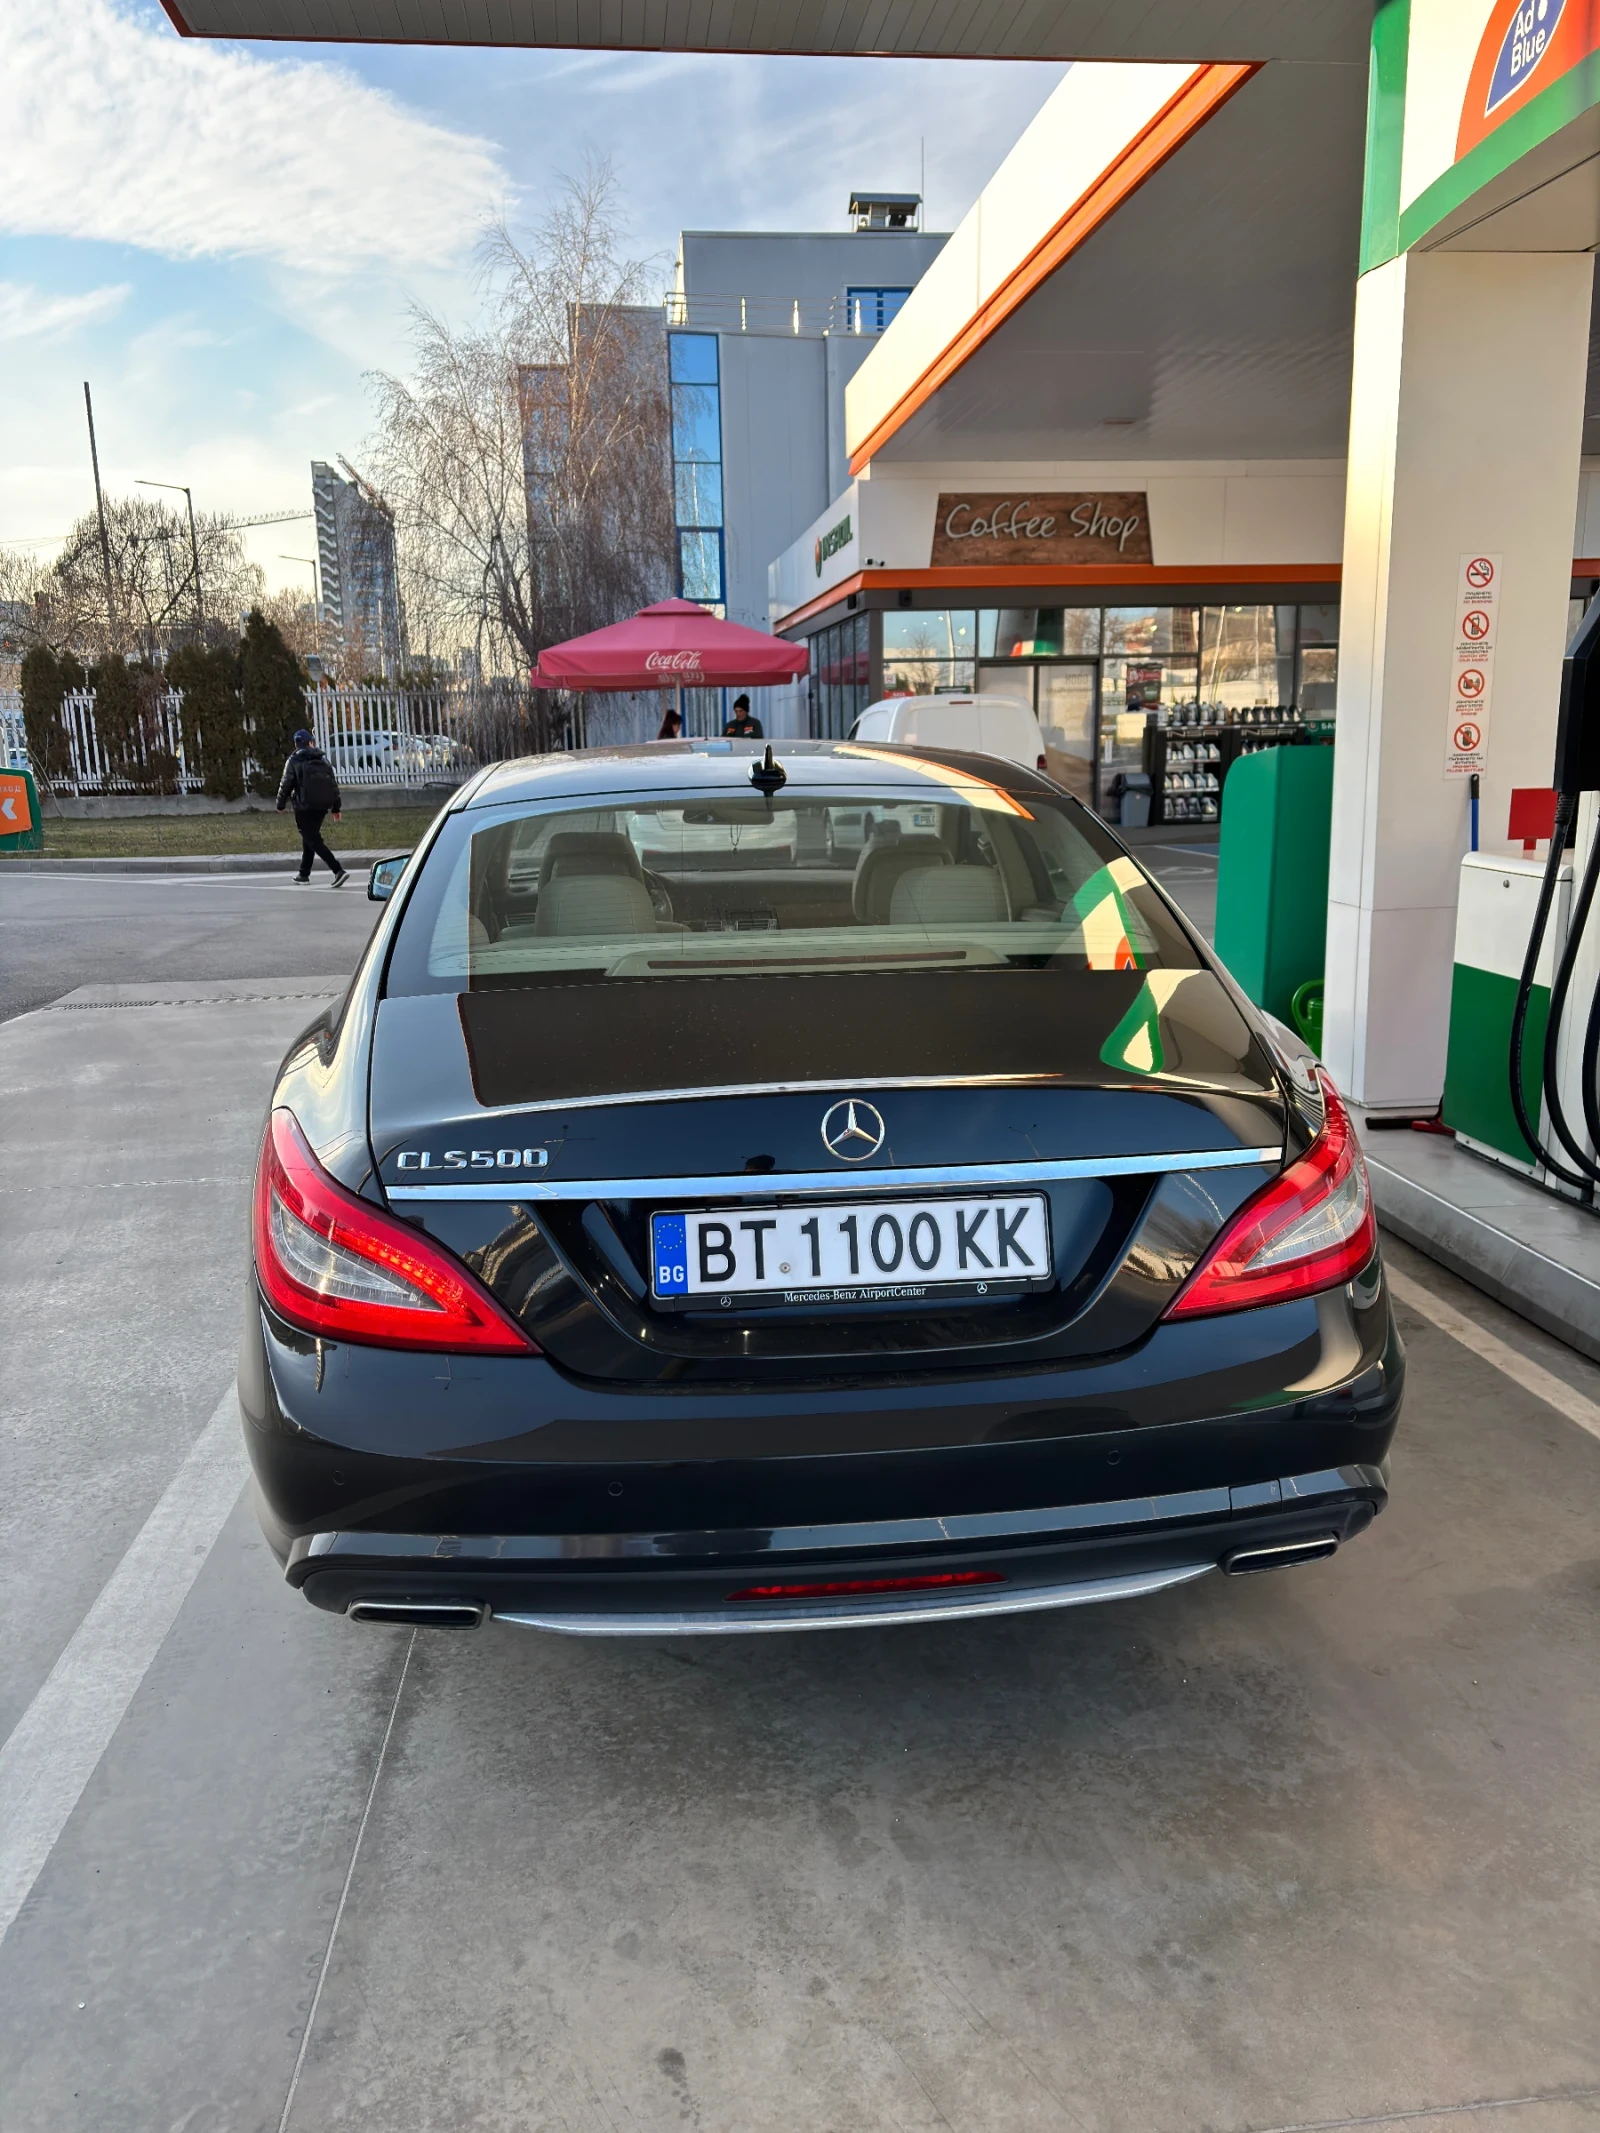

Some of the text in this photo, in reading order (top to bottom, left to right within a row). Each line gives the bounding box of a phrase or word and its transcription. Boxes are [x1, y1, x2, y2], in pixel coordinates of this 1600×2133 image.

[1513, 0, 1535, 45] Ad
[1511, 28, 1545, 77] Blue
[946, 501, 1139, 552] Coffee Shop
[397, 1147, 549, 1171] CLS500
[698, 1207, 1037, 1283] BT 1100 KK
[659, 1265, 686, 1284] BG
[784, 1289, 857, 1303] Mercedes-Benz
